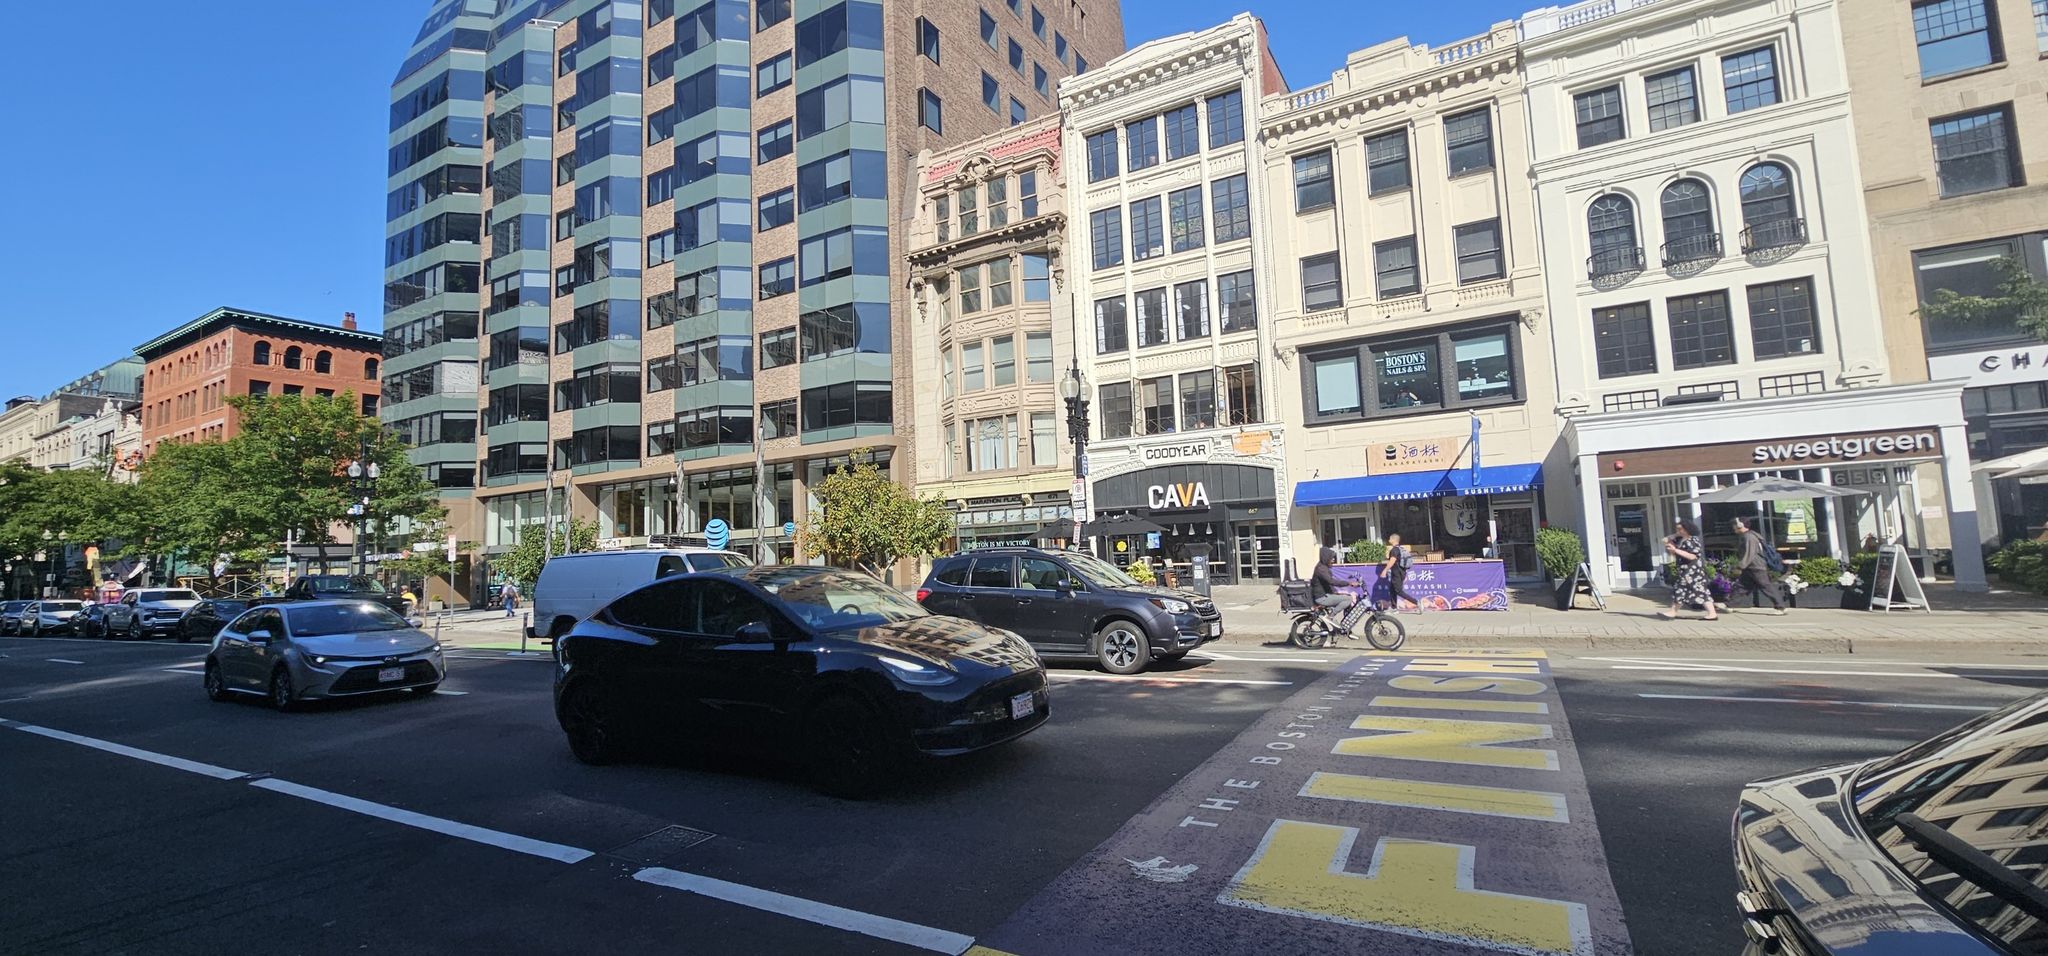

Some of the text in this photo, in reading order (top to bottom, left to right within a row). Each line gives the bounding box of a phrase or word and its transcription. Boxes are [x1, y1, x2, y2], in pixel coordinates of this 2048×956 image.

[1385, 352, 1426, 367] BOSTON'S
[1386, 367, 1407, 376] NAILS
[1146, 444, 1206, 460] GOODYEAR
[1754, 433, 1936, 461] sweetgreen
[1834, 470, 1883, 485] 659
[1148, 482, 1210, 509] CAVA
[1378, 485, 1538, 500] SAKABAYASHI SUSHI TAVERN
[970, 497, 1001, 505] MARATHON
[1006, 539, 1030, 547] VICTORY
[1179, 778, 1261, 829] THE
[1249, 705, 1334, 766] BOSTON
[1217, 658, 1592, 956] FINISH
